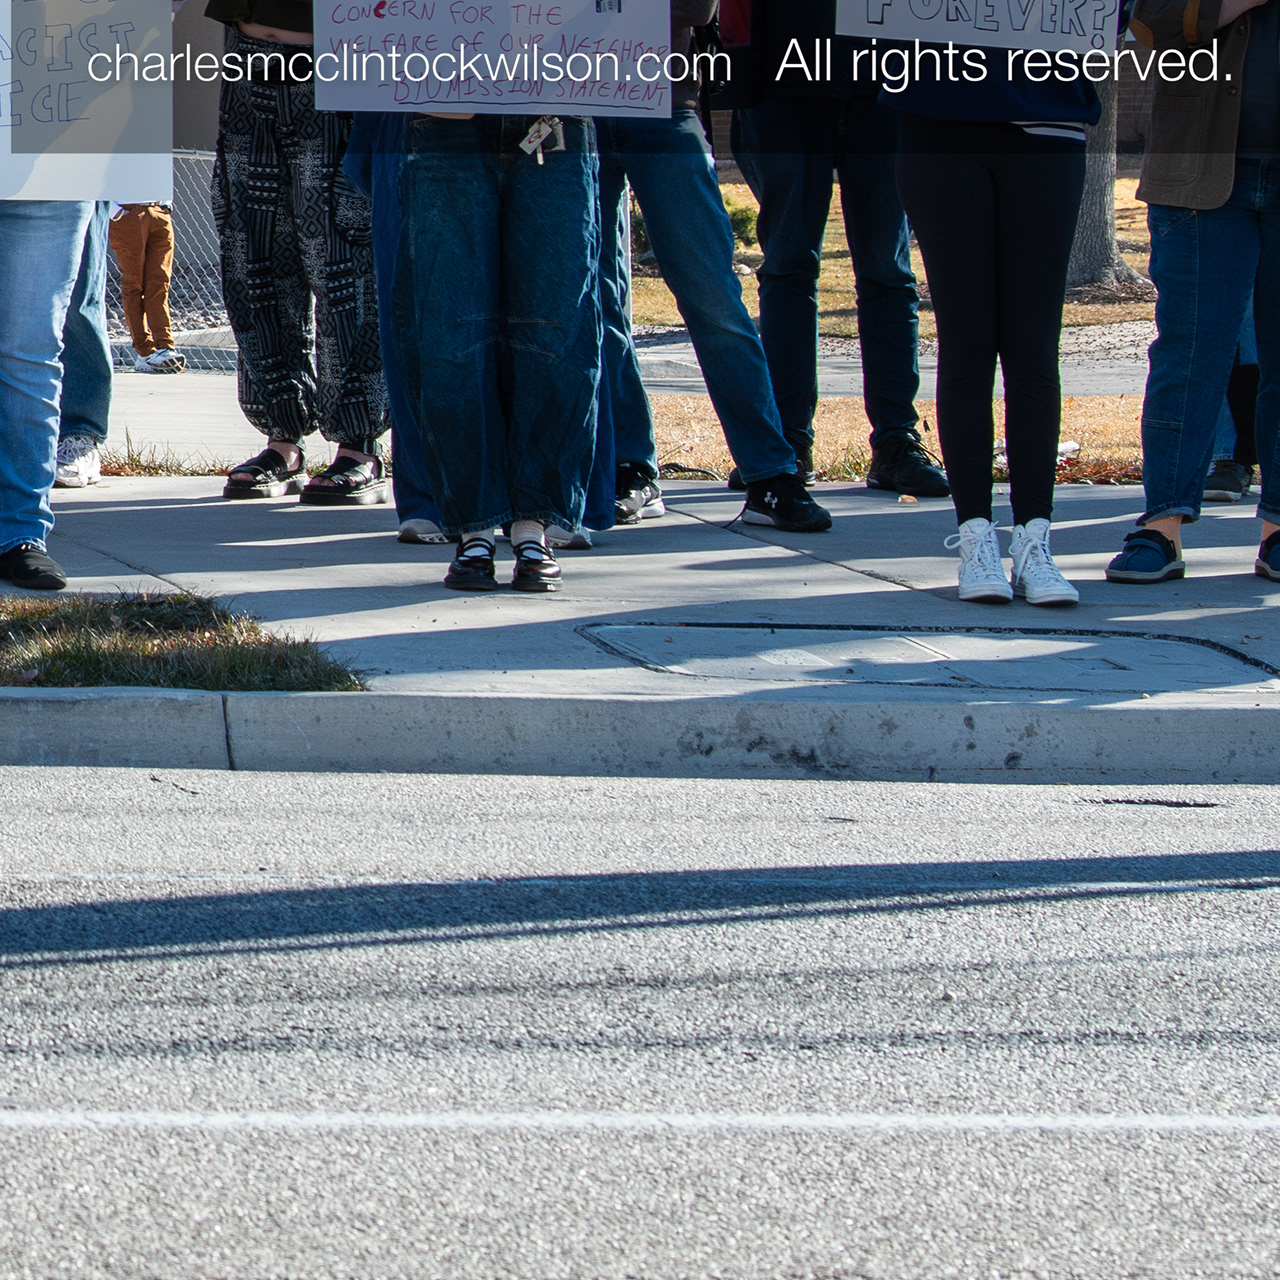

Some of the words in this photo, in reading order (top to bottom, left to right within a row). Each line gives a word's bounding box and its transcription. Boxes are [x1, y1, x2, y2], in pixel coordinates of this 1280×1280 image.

[331, 0, 436, 25] CONCERN
[450, 0, 494, 24] FOR
[511, 4, 564, 25] THE
[500, 34, 544, 52] OUR
[446, 75, 543, 100] MISSION
[556, 75, 669, 106] STATEMENT
